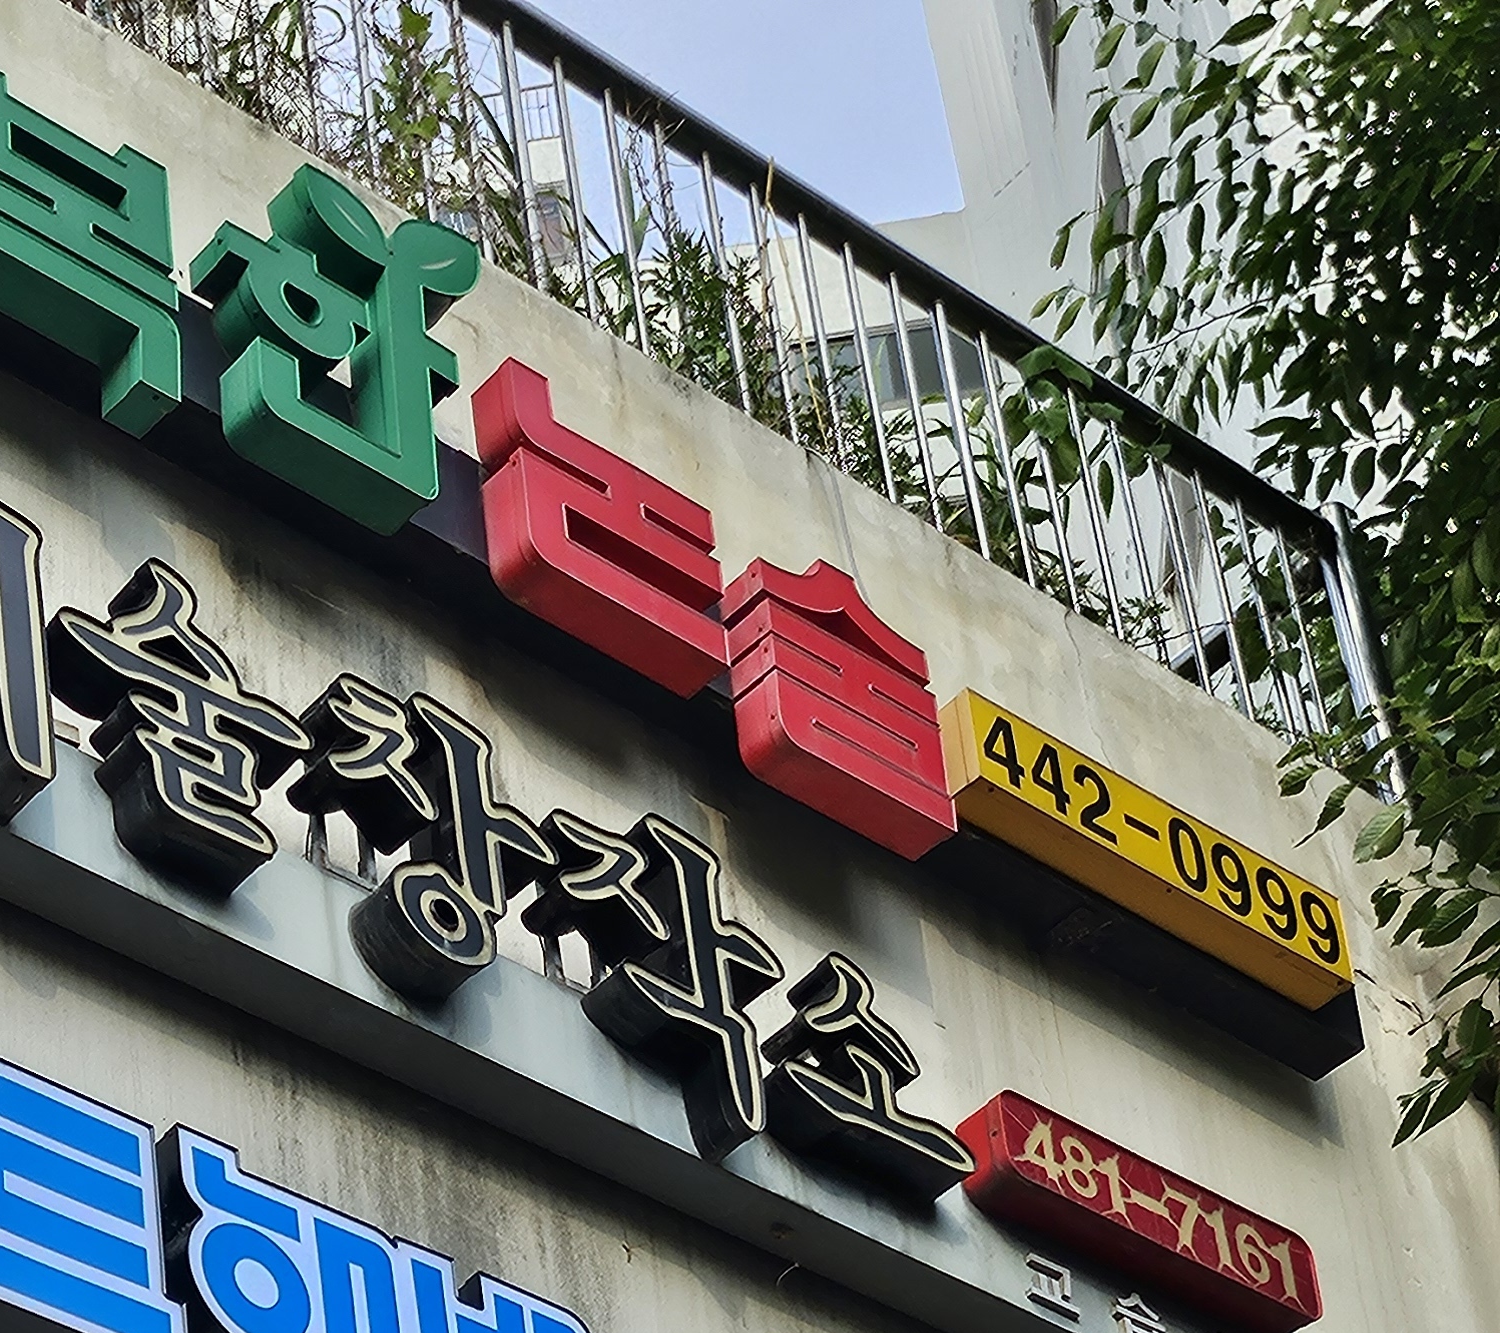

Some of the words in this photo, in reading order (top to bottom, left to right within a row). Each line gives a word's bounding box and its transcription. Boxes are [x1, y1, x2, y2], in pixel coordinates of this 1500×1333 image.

[474, 357, 957, 850] 논술
[982, 716, 1341, 967] 442-0999
[1015, 1118, 1299, 1306] 481-7161
